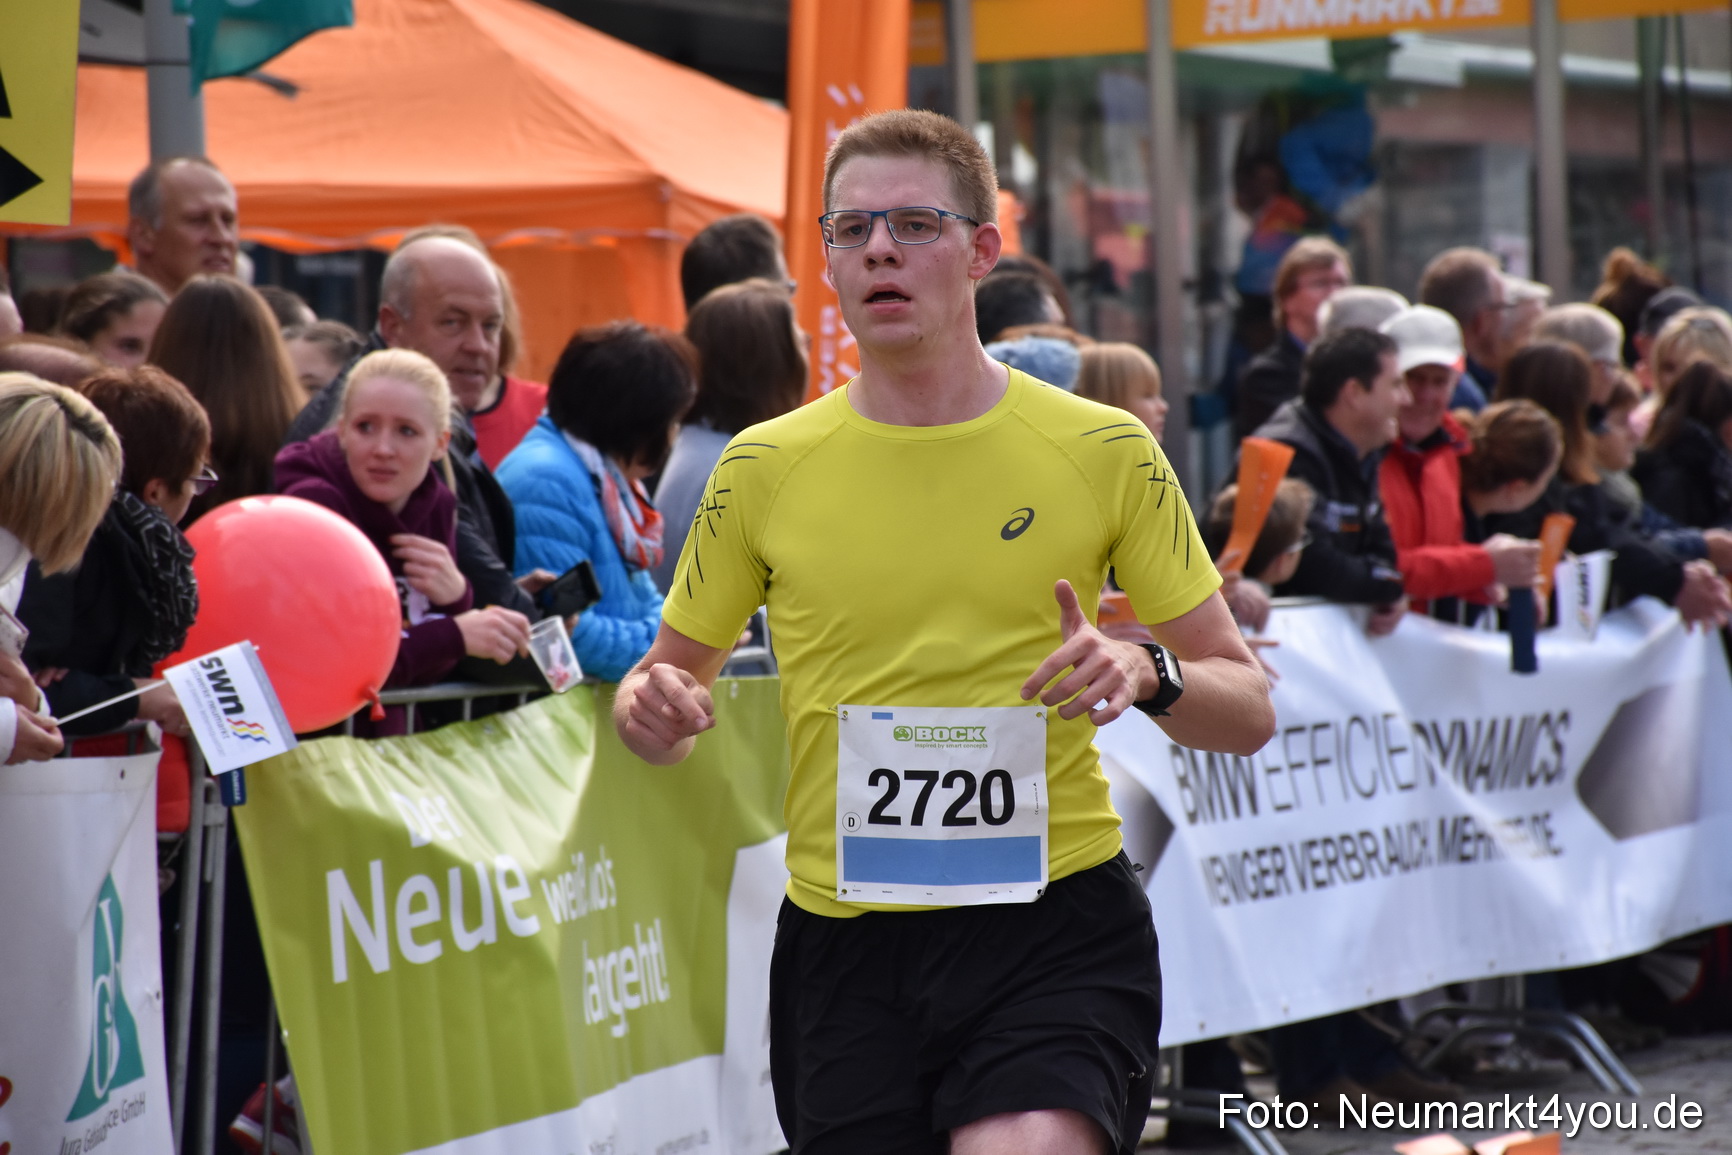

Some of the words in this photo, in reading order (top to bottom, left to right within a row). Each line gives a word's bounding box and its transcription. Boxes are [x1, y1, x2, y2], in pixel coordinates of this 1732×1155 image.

[199, 656, 246, 716] swn
[914, 726, 988, 742] BOCK
[867, 768, 1016, 827] 2720
[1169, 741, 1261, 826] BMW
[847, 816, 856, 829] D
[325, 854, 541, 985] Neue
